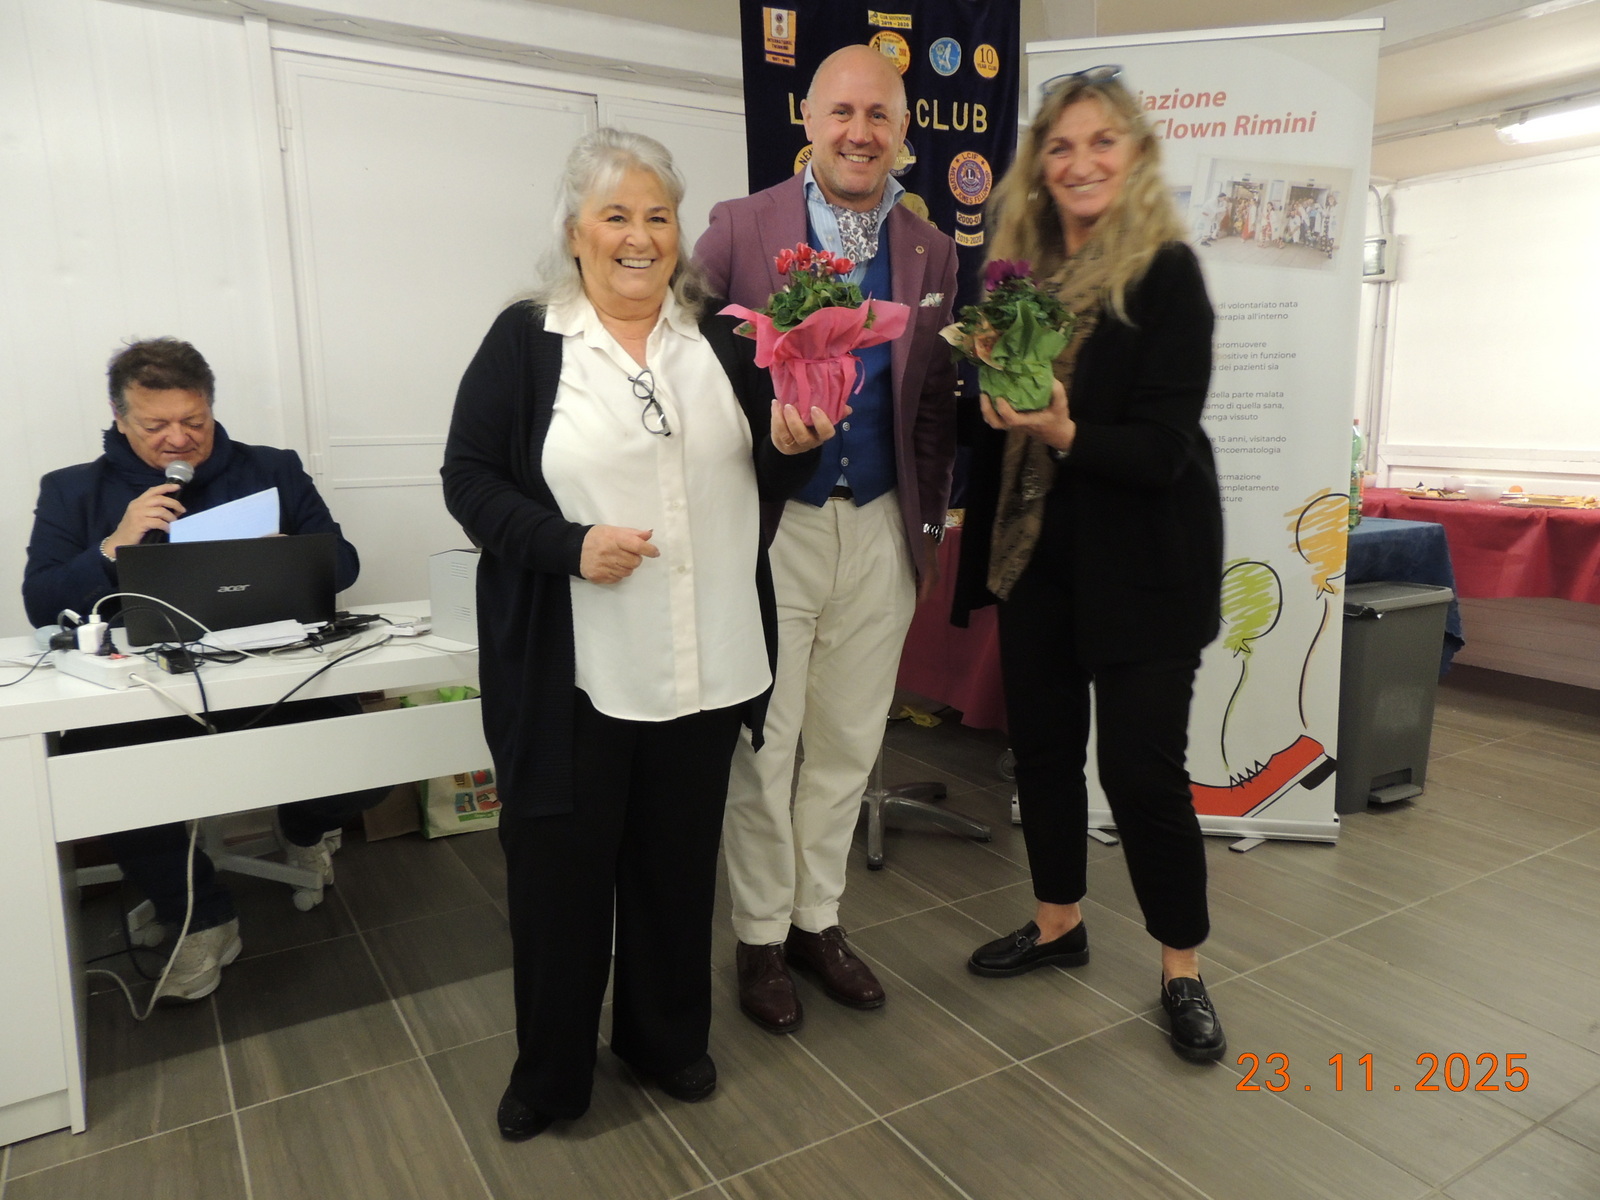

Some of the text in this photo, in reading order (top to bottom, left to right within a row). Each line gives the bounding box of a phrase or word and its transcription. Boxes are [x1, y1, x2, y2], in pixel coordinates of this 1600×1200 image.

[980, 47, 994, 64] 10
[1137, 87, 1227, 111] iazione
[915, 98, 988, 134] CLUB
[1233, 110, 1317, 137] Rimini
[961, 152, 979, 160] LCIF
[956, 191, 974, 205] JONES
[1227, 302, 1278, 310] volontariato
[1215, 313, 1246, 322] terapia
[1216, 341, 1267, 350] promuovere
[1250, 352, 1258, 360] in
[1260, 351, 1297, 359] funzione
[1218, 363, 1232, 371] dei
[1233, 363, 1266, 372] pazienti
[1267, 363, 1279, 371] sia
[1210, 391, 1230, 399] della
[1231, 391, 1254, 400] parte
[1255, 390, 1284, 398] malata
[1236, 402, 1261, 411] quella
[1262, 402, 1285, 410] sana,
[1229, 413, 1259, 421] vissuto
[1218, 435, 1226, 443] 15
[1227, 435, 1248, 444] anni,
[1249, 435, 1287, 443] visitando
[1213, 446, 1281, 455] Oncoematologia
[217, 584, 251, 593] acer
